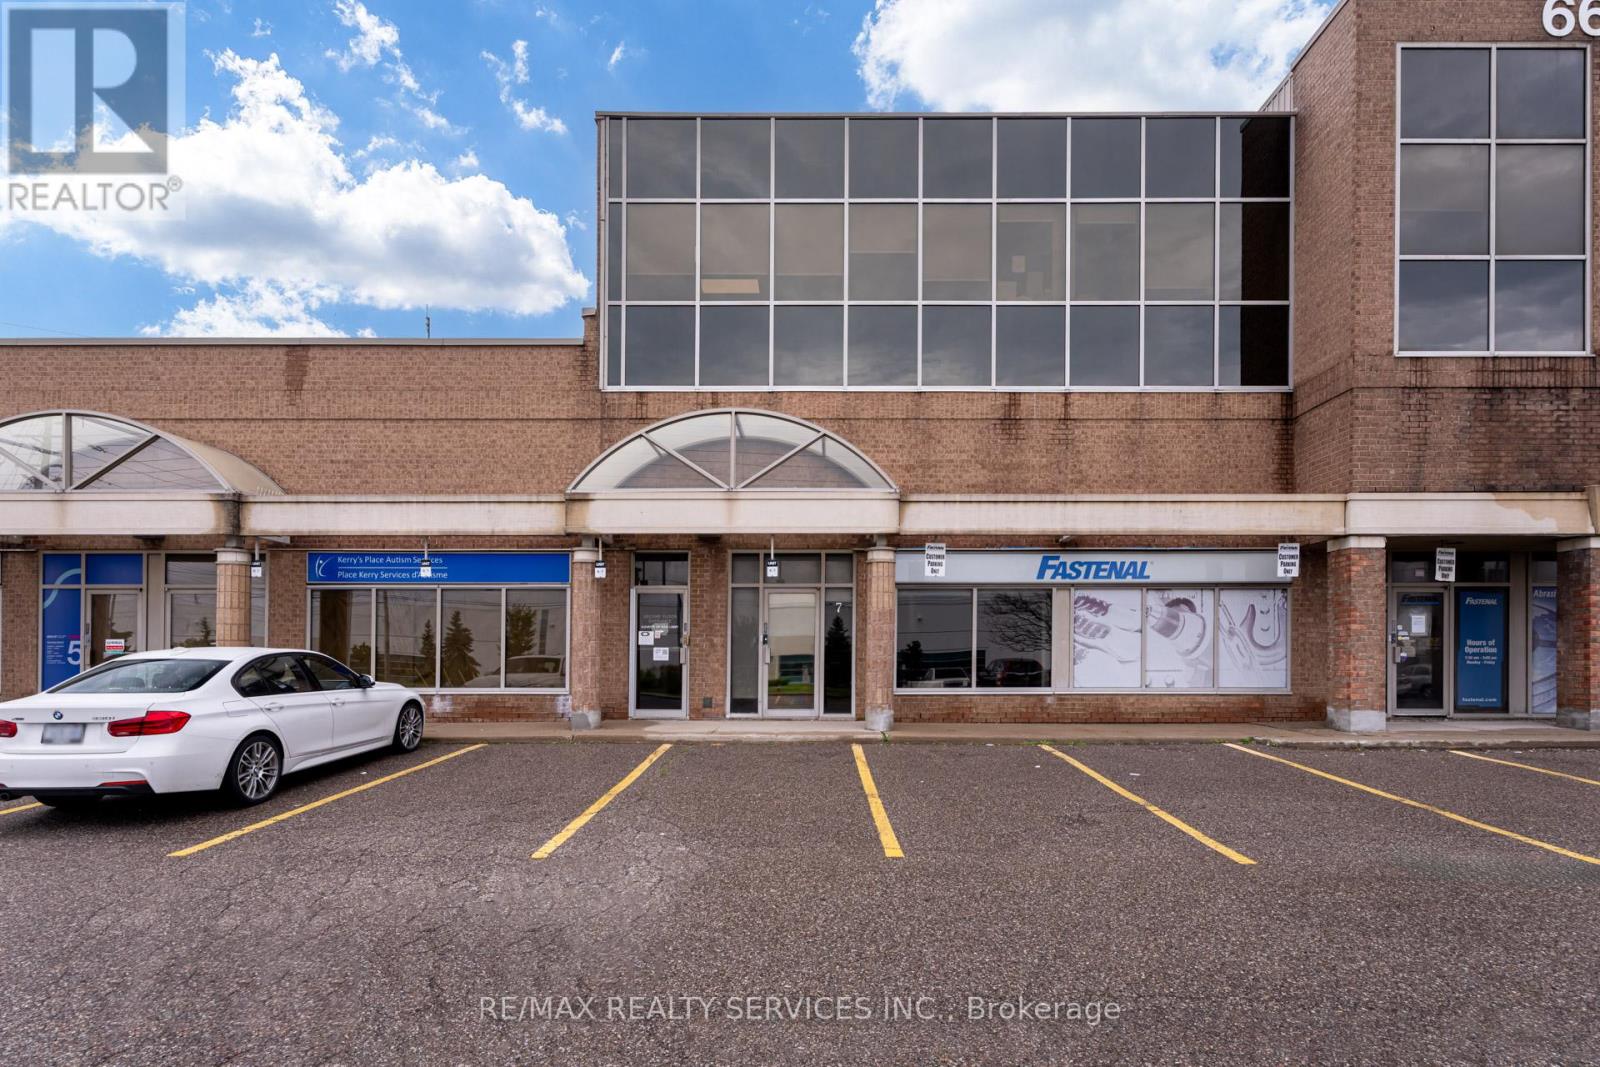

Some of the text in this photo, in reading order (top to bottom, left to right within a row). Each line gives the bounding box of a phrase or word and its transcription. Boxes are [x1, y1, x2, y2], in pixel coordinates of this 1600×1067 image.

[1542, 0, 1600, 37] 66
[337, 555, 363, 565] Kerry's
[364, 556, 384, 564] Place
[386, 556, 412, 564] Autism
[337, 571, 357, 579] Place
[358, 571, 379, 580] Kerry
[380, 571, 410, 579] Services
[835, 602, 842, 613] 7
[1464, 646, 1497, 654] Operation
